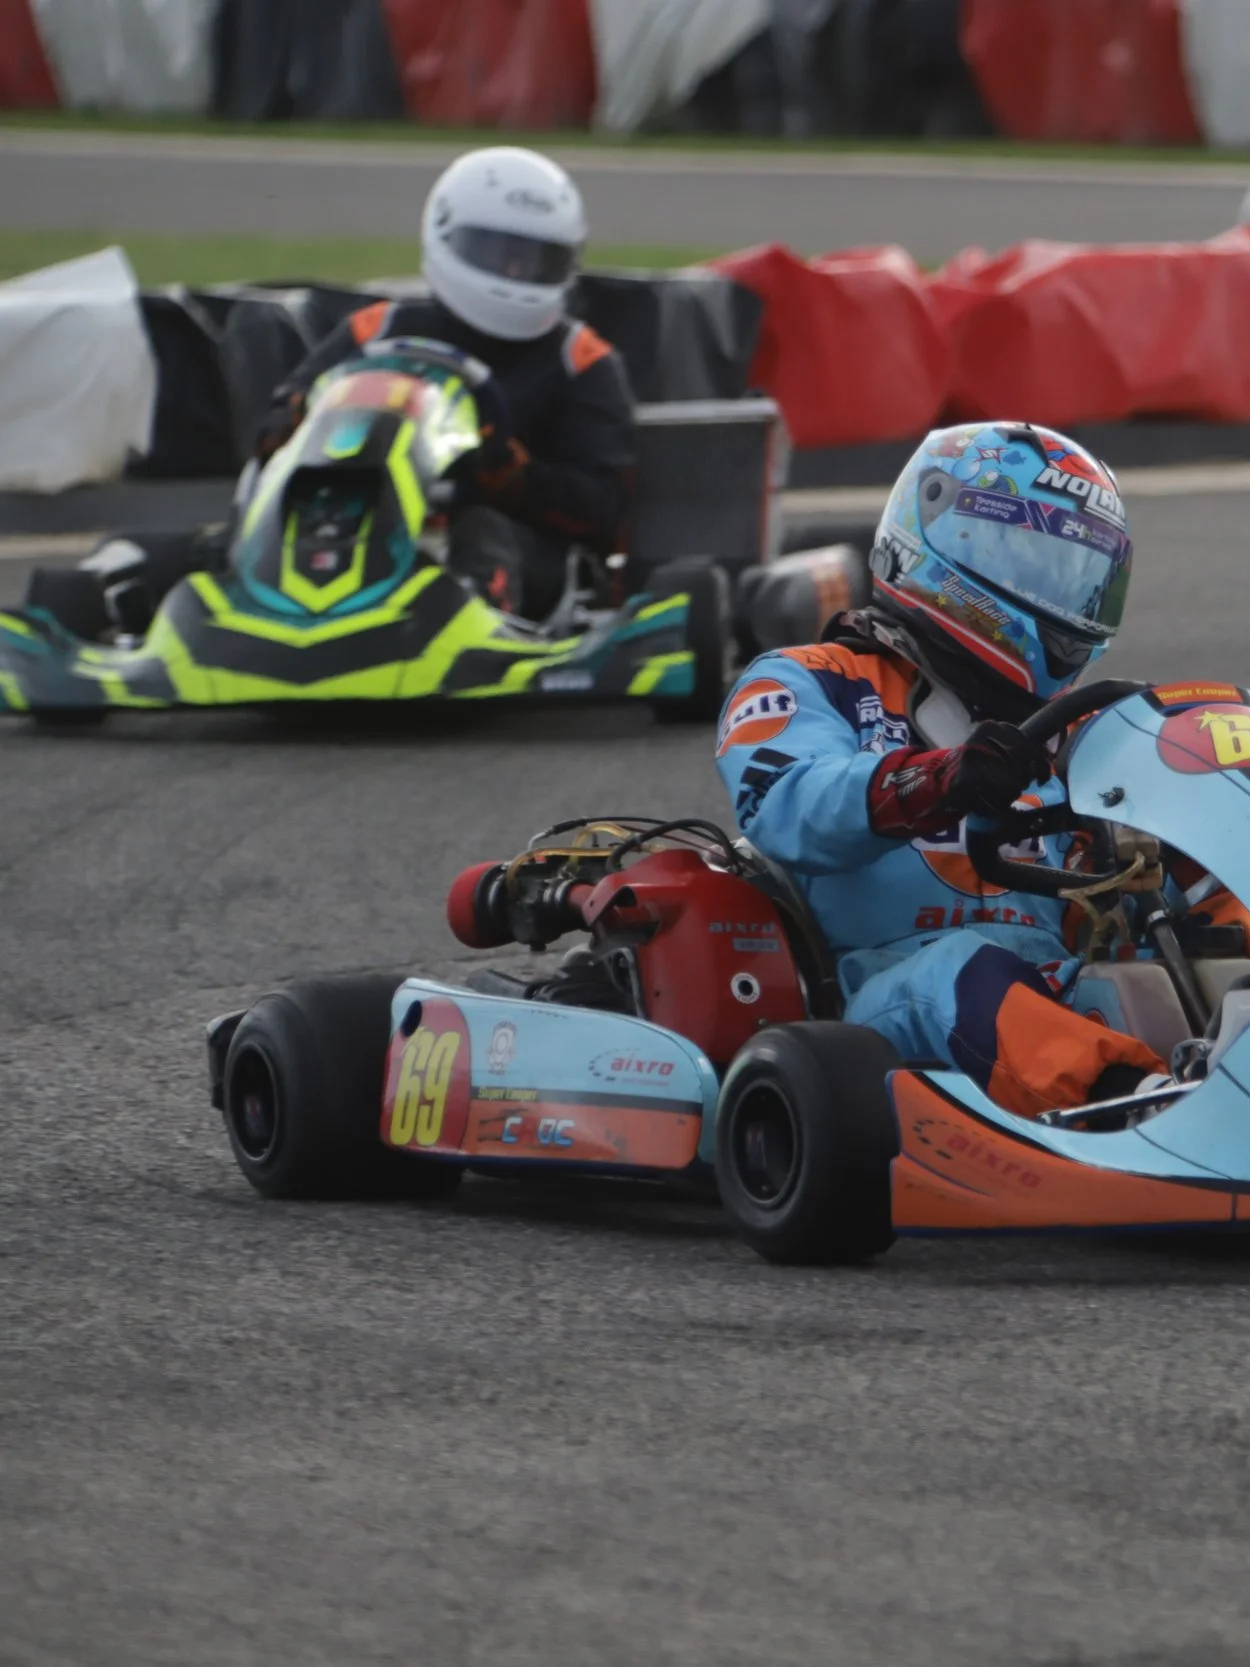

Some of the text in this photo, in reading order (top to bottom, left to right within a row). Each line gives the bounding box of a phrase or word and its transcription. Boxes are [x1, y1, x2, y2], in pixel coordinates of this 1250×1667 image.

[723, 694, 793, 738] ulf
[390, 1028, 461, 1147] 69
[610, 1054, 676, 1077] aixro
